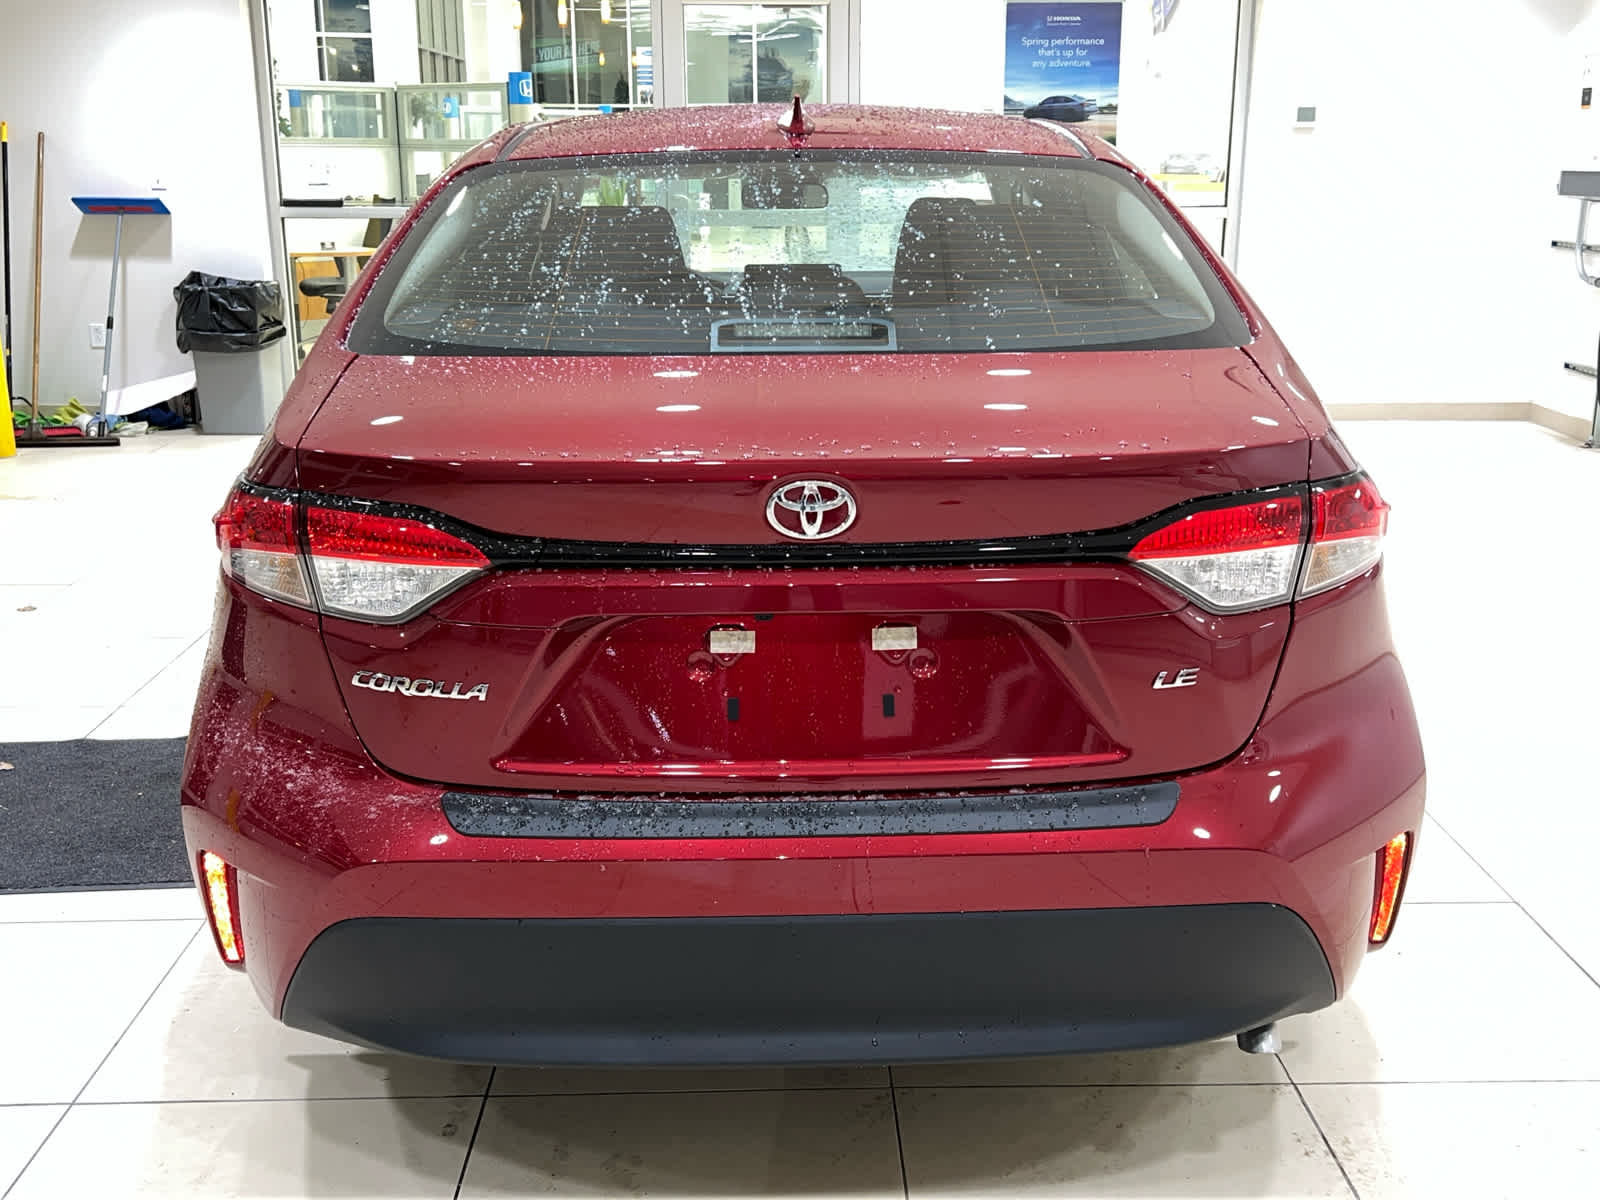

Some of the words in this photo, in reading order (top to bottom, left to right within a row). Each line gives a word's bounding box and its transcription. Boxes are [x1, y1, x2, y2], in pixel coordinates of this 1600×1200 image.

[1022, 37, 1049, 48] Spring
[1051, 36, 1105, 47] performance
[1038, 48, 1061, 56] that's
[1062, 50, 1074, 58] up
[1076, 48, 1088, 56] for
[351, 670, 489, 701] COROLLA
[1152, 667, 1200, 689] LE
